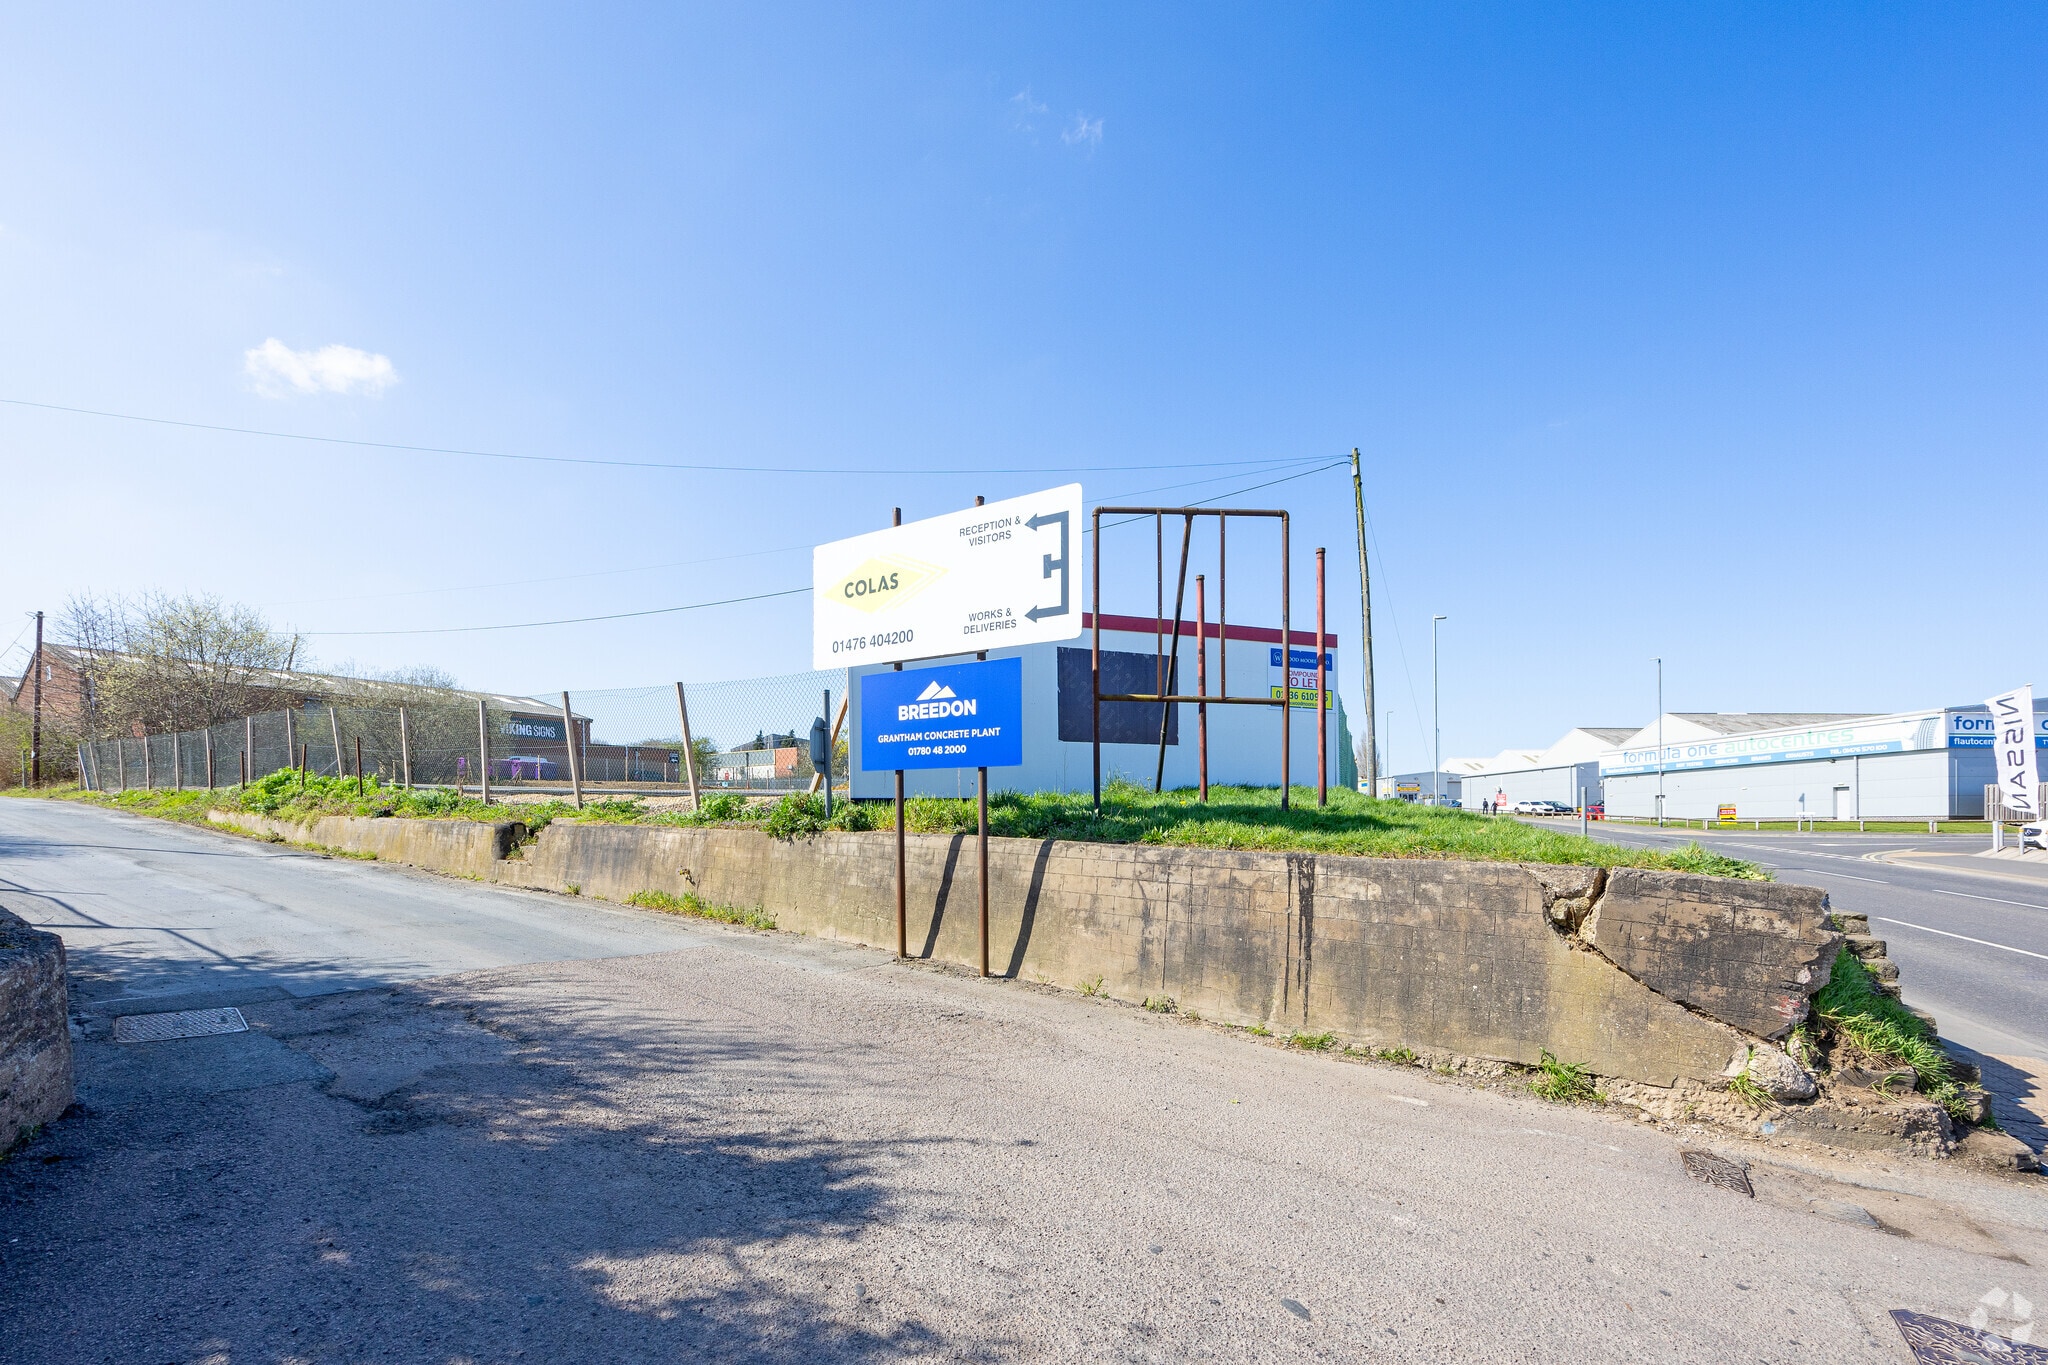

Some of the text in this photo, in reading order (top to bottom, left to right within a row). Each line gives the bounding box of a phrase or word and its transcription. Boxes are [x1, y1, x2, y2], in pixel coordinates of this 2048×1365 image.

[959, 515, 1021, 537] RECEPTION &
[969, 530, 1012, 547] VISITORS
[844, 572, 899, 598] COLAS
[968, 607, 1012, 622] WORKS &
[963, 619, 1017, 635] DELIVERIES
[832, 629, 914, 653] 01476 404200
[1289, 670, 1318, 679] OMPOUND
[898, 699, 977, 721] BREEDON
[1953, 715, 1994, 730] form
[533, 725, 556, 738] SIGNS
[878, 727, 1001, 744] GRANTHAM CONCRETE PLANT
[908, 744, 967, 756] 01780 48 2000
[1623, 746, 1681, 764] formula
[1687, 744, 1718, 757] one
[1724, 729, 1854, 754] autocentres
